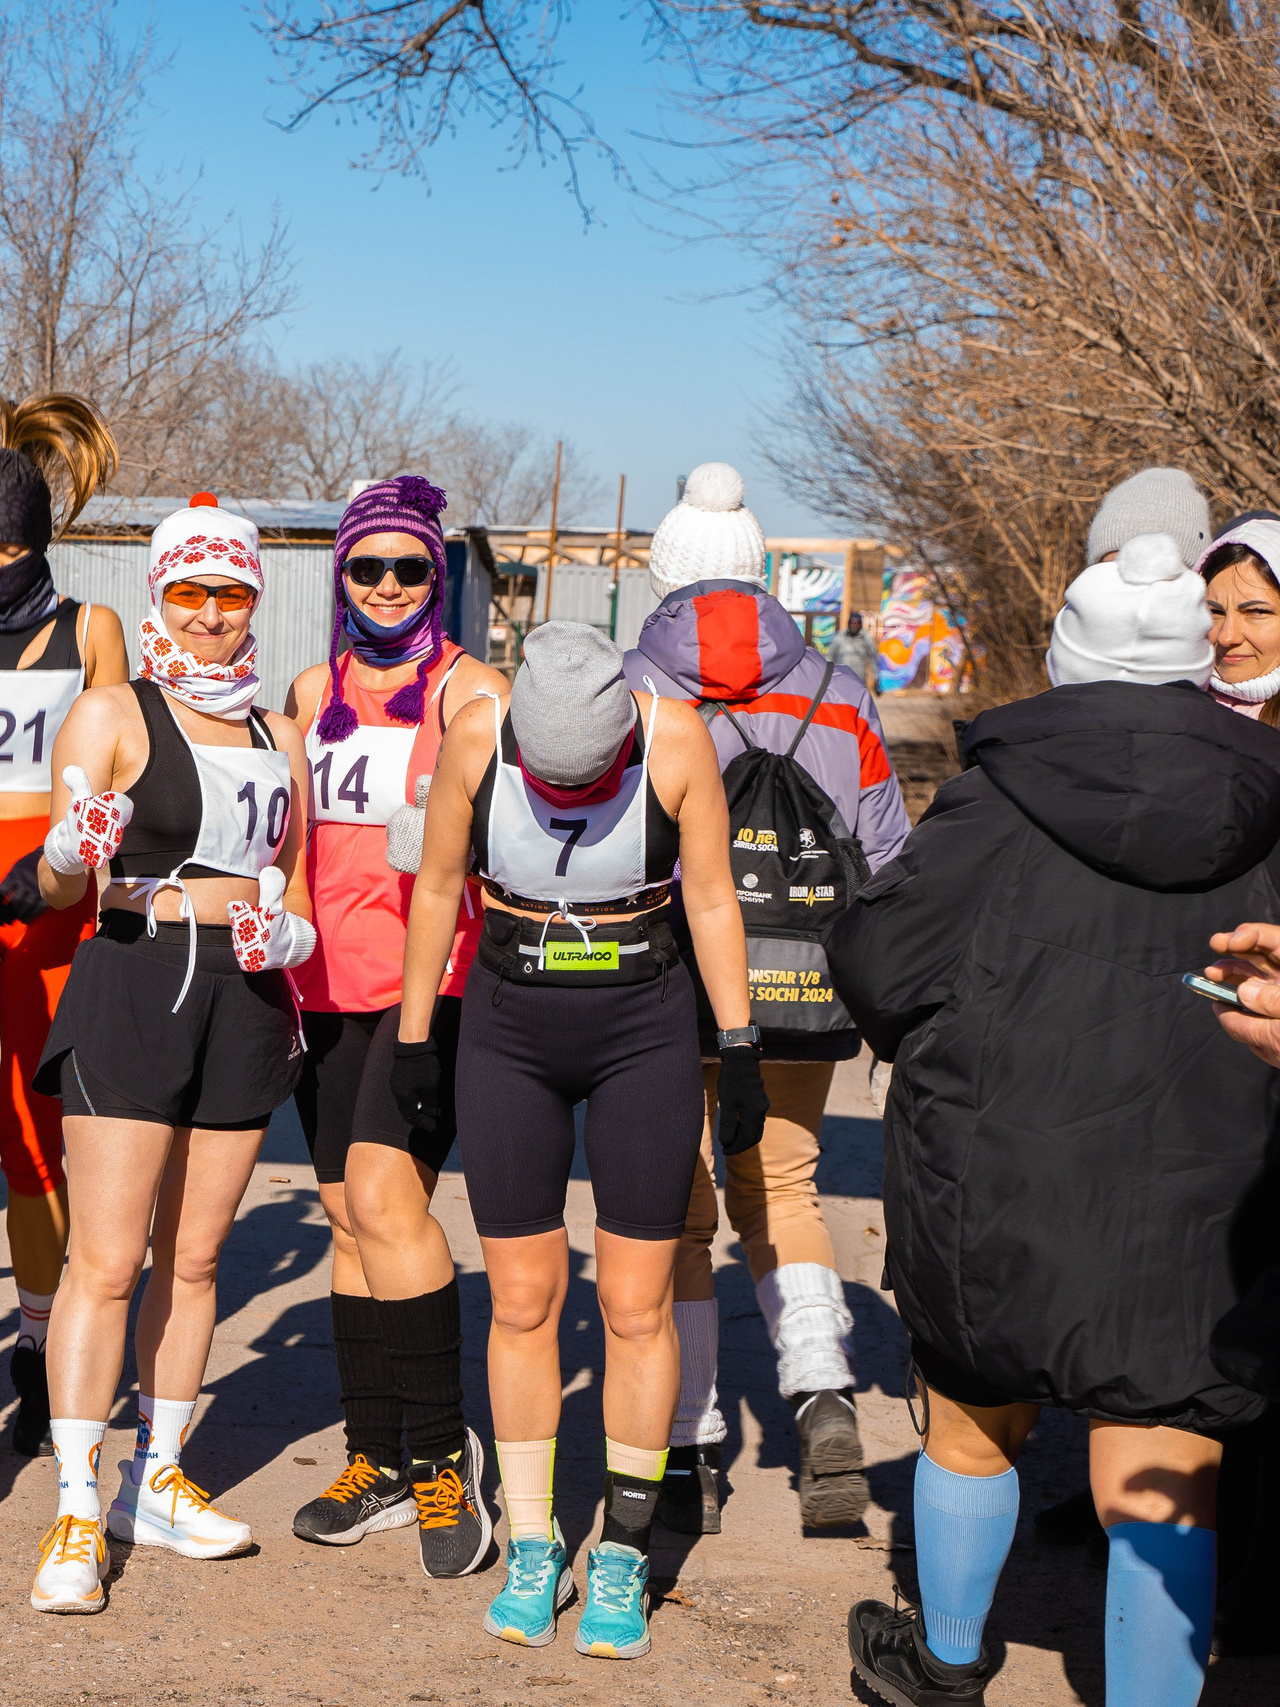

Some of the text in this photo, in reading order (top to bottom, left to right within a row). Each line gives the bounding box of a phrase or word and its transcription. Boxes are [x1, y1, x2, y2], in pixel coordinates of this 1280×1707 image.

[313, 751, 369, 814] 14
[237, 781, 290, 849] 10
[737, 828, 754, 843] 10
[549, 816, 588, 877] 7
[733, 840, 757, 851] SIRIUS
[789, 886, 835, 898] IRON STAR
[799, 970, 821, 987] 1/8
[756, 986, 800, 1002] SOCHI
[800, 988, 834, 1003] 2024
